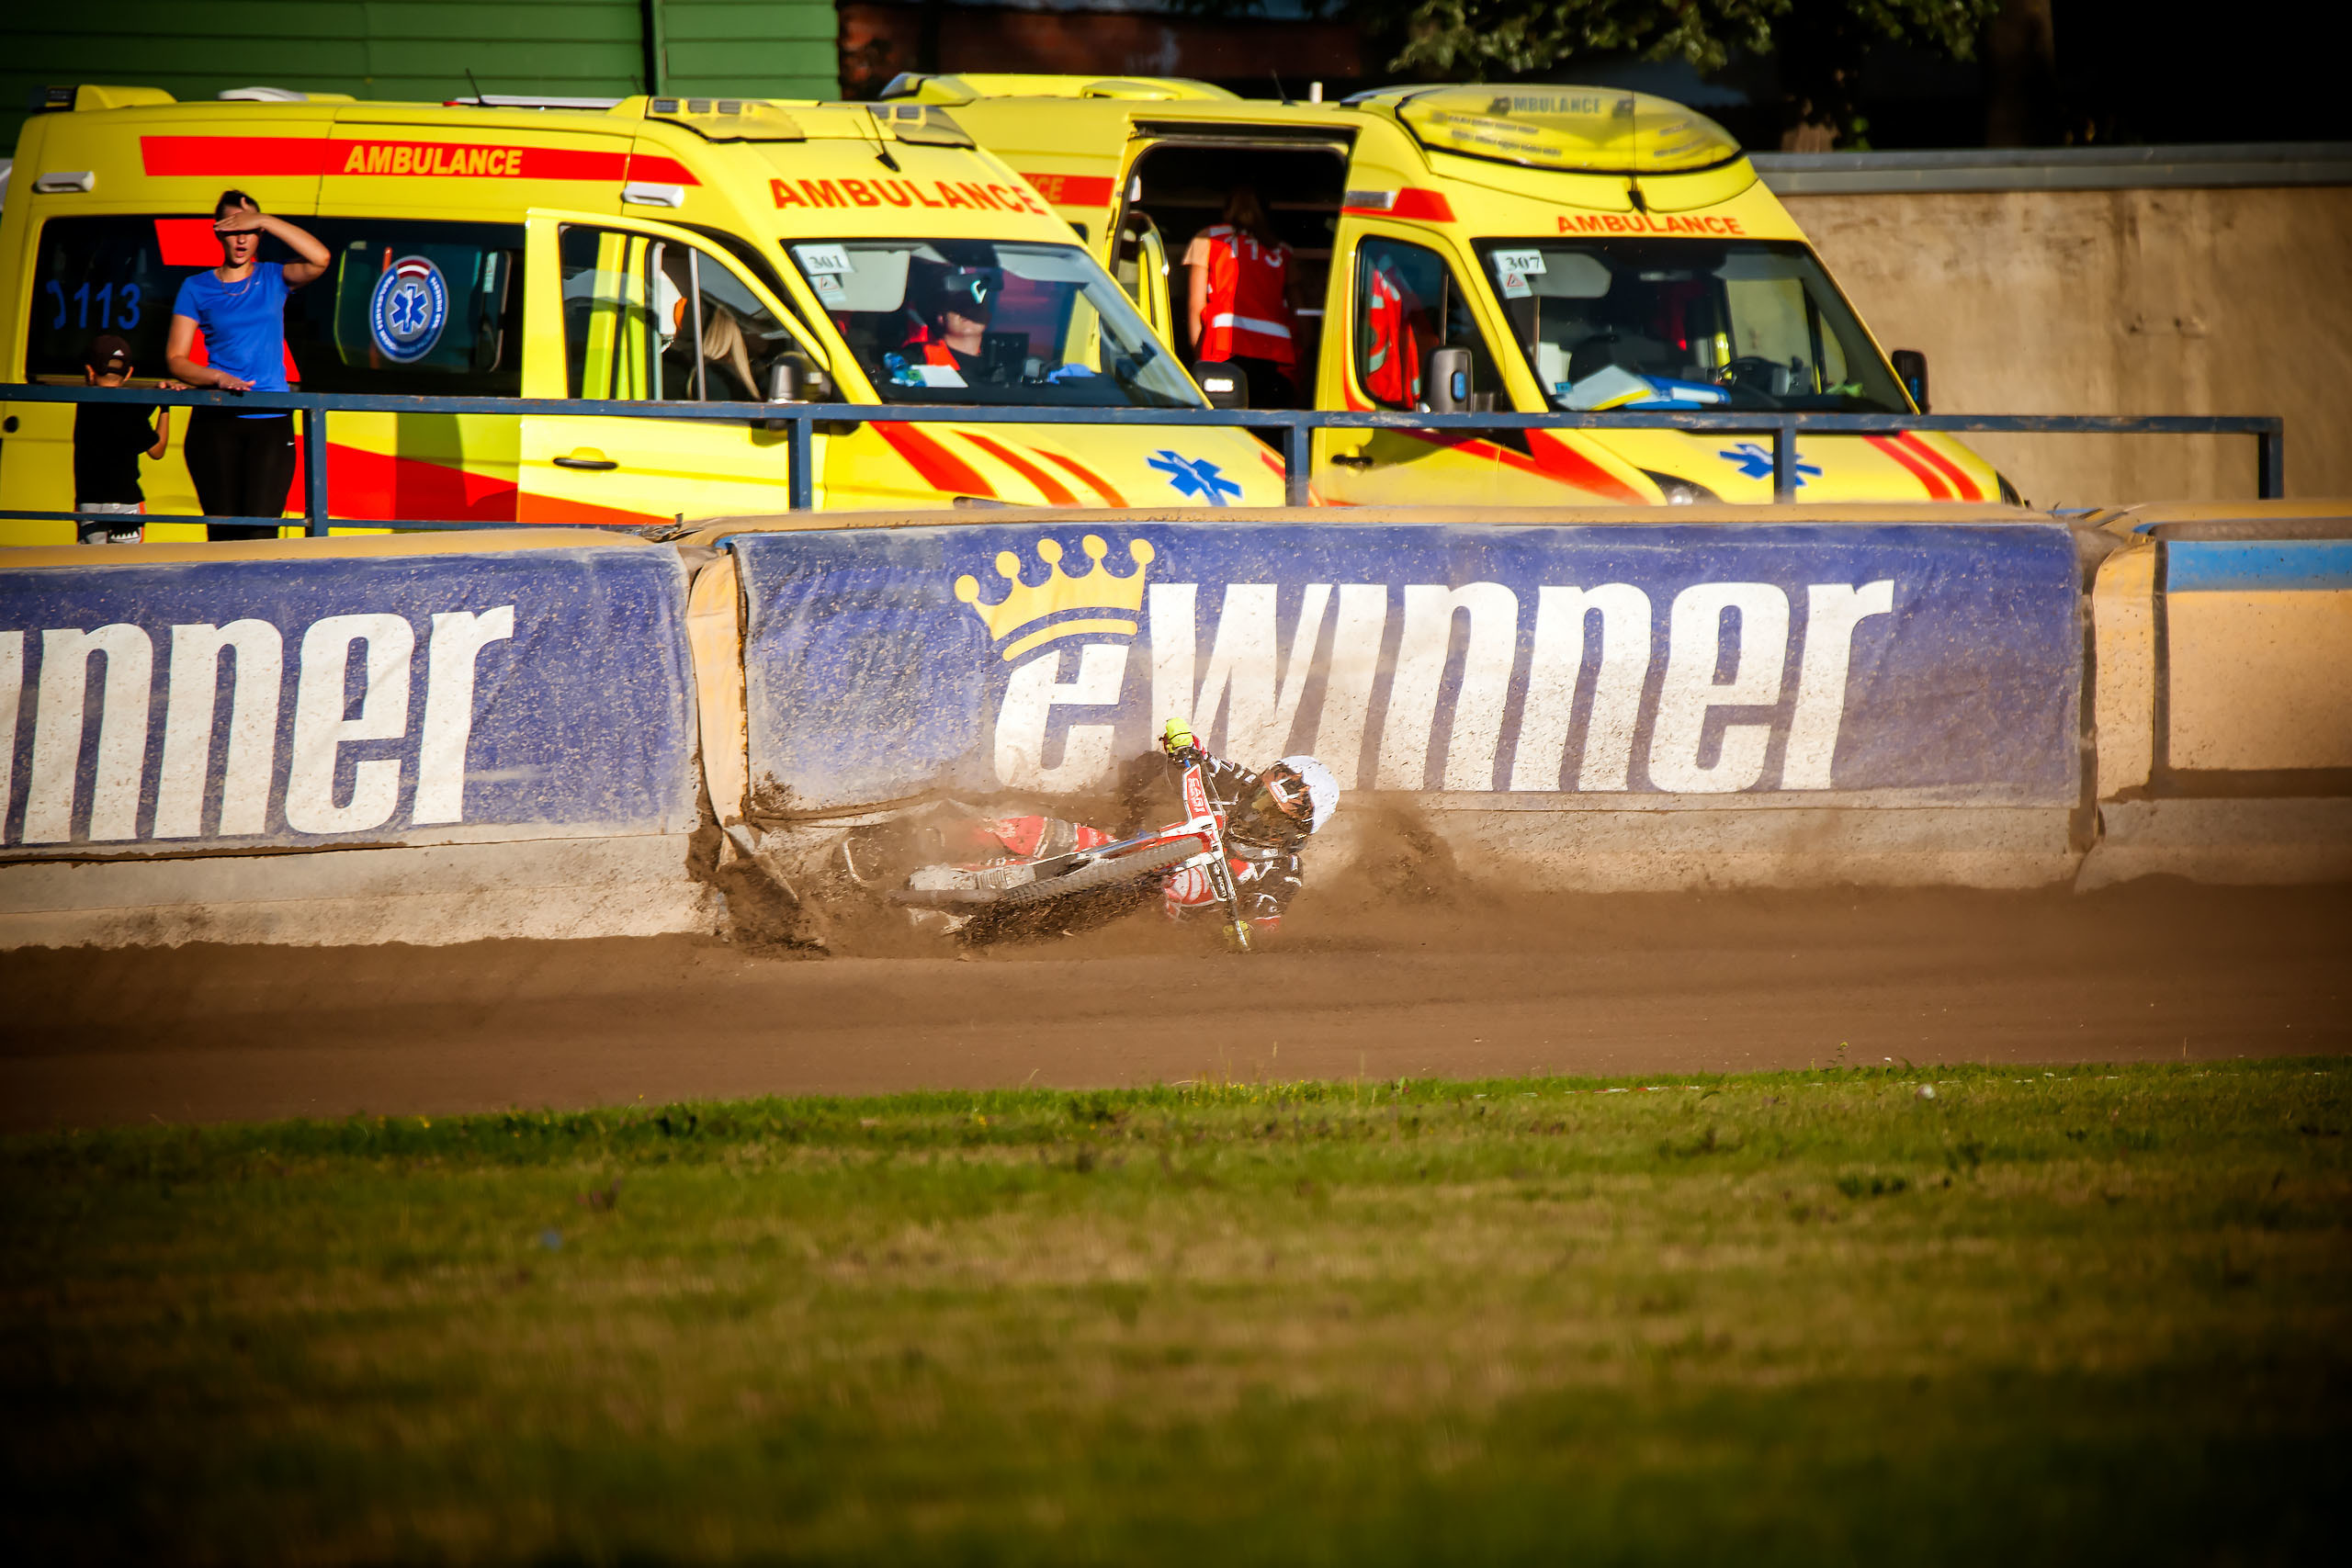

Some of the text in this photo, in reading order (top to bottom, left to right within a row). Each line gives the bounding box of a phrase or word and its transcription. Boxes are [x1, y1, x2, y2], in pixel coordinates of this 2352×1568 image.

[1512, 96, 1602, 114] MBULANCE
[344, 144, 524, 175] AMBULANCE
[769, 178, 1048, 216] AMBULANCE
[1556, 215, 1746, 235] AMBULANCE
[808, 255, 843, 269] 301
[1505, 255, 1541, 271] 307
[74, 281, 141, 330] 113
